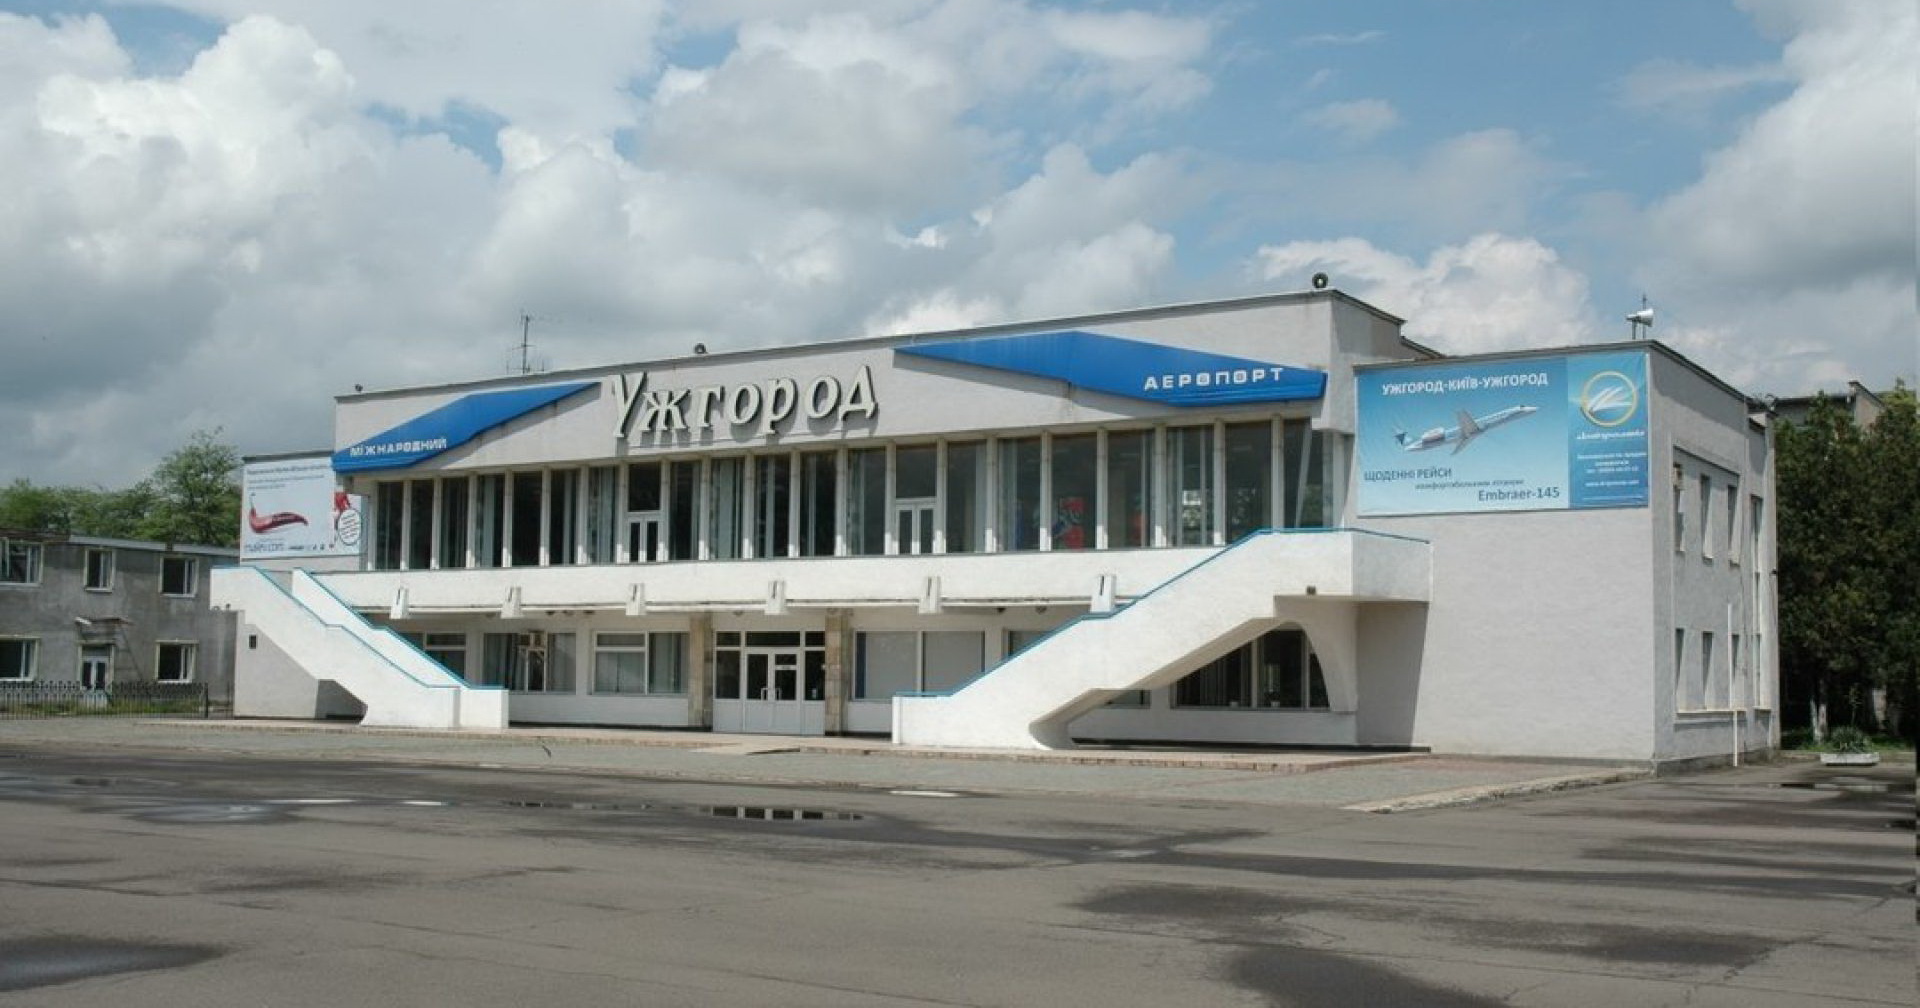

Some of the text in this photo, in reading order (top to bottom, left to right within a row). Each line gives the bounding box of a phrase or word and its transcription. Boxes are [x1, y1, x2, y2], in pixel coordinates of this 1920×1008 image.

[1144, 367, 1284, 391] АЕРОПОРТ
[1382, 373, 1549, 395] УЖГОРОД-КИЇВ-УЖГОРОД
[609, 365, 877, 438] Ужгород
[350, 436, 447, 456] МІЖНАРОДНИЙ
[1363, 466, 1452, 482] ЩОДЕННІ РЕЙСИ
[1478, 486, 1560, 501] Embraer-145
